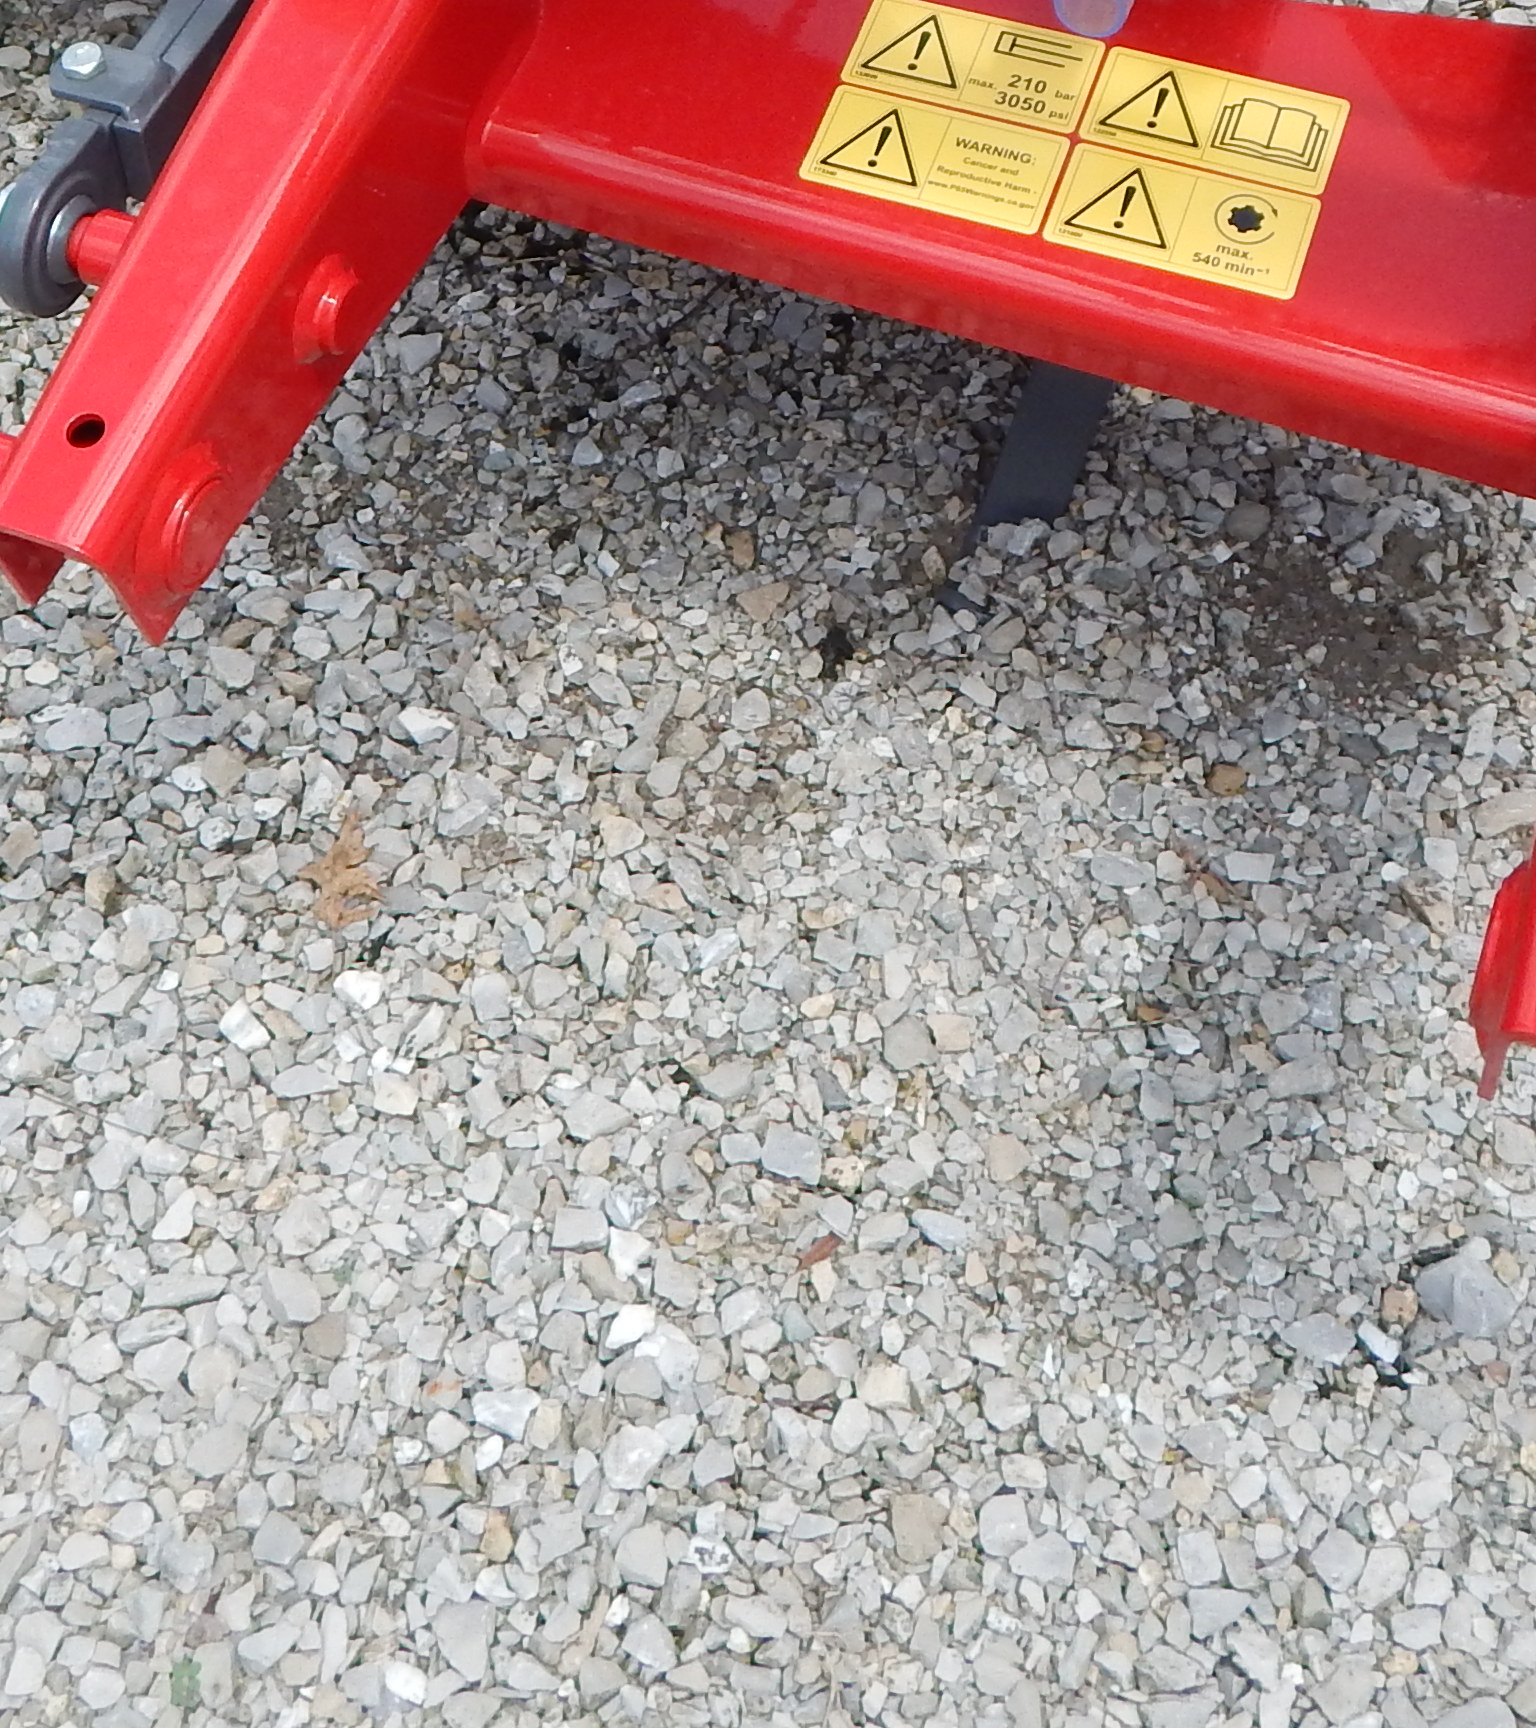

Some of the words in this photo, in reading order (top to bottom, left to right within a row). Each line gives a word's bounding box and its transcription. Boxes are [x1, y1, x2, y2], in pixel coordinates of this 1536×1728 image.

[968, 77, 997, 90] max.
[1007, 74, 1047, 94] 210
[1054, 90, 1075, 101] bar
[994, 91, 1046, 114] 3050
[1048, 110, 1069, 120] psi
[955, 136, 1037, 166] WARNING:
[936, 164, 1002, 187] Reproductive
[1004, 181, 1031, 194] Harm
[963, 156, 998, 171] Cancer
[1000, 167, 1019, 176] and
[1192, 252, 1221, 268] 540
[1216, 244, 1253, 261] max.
